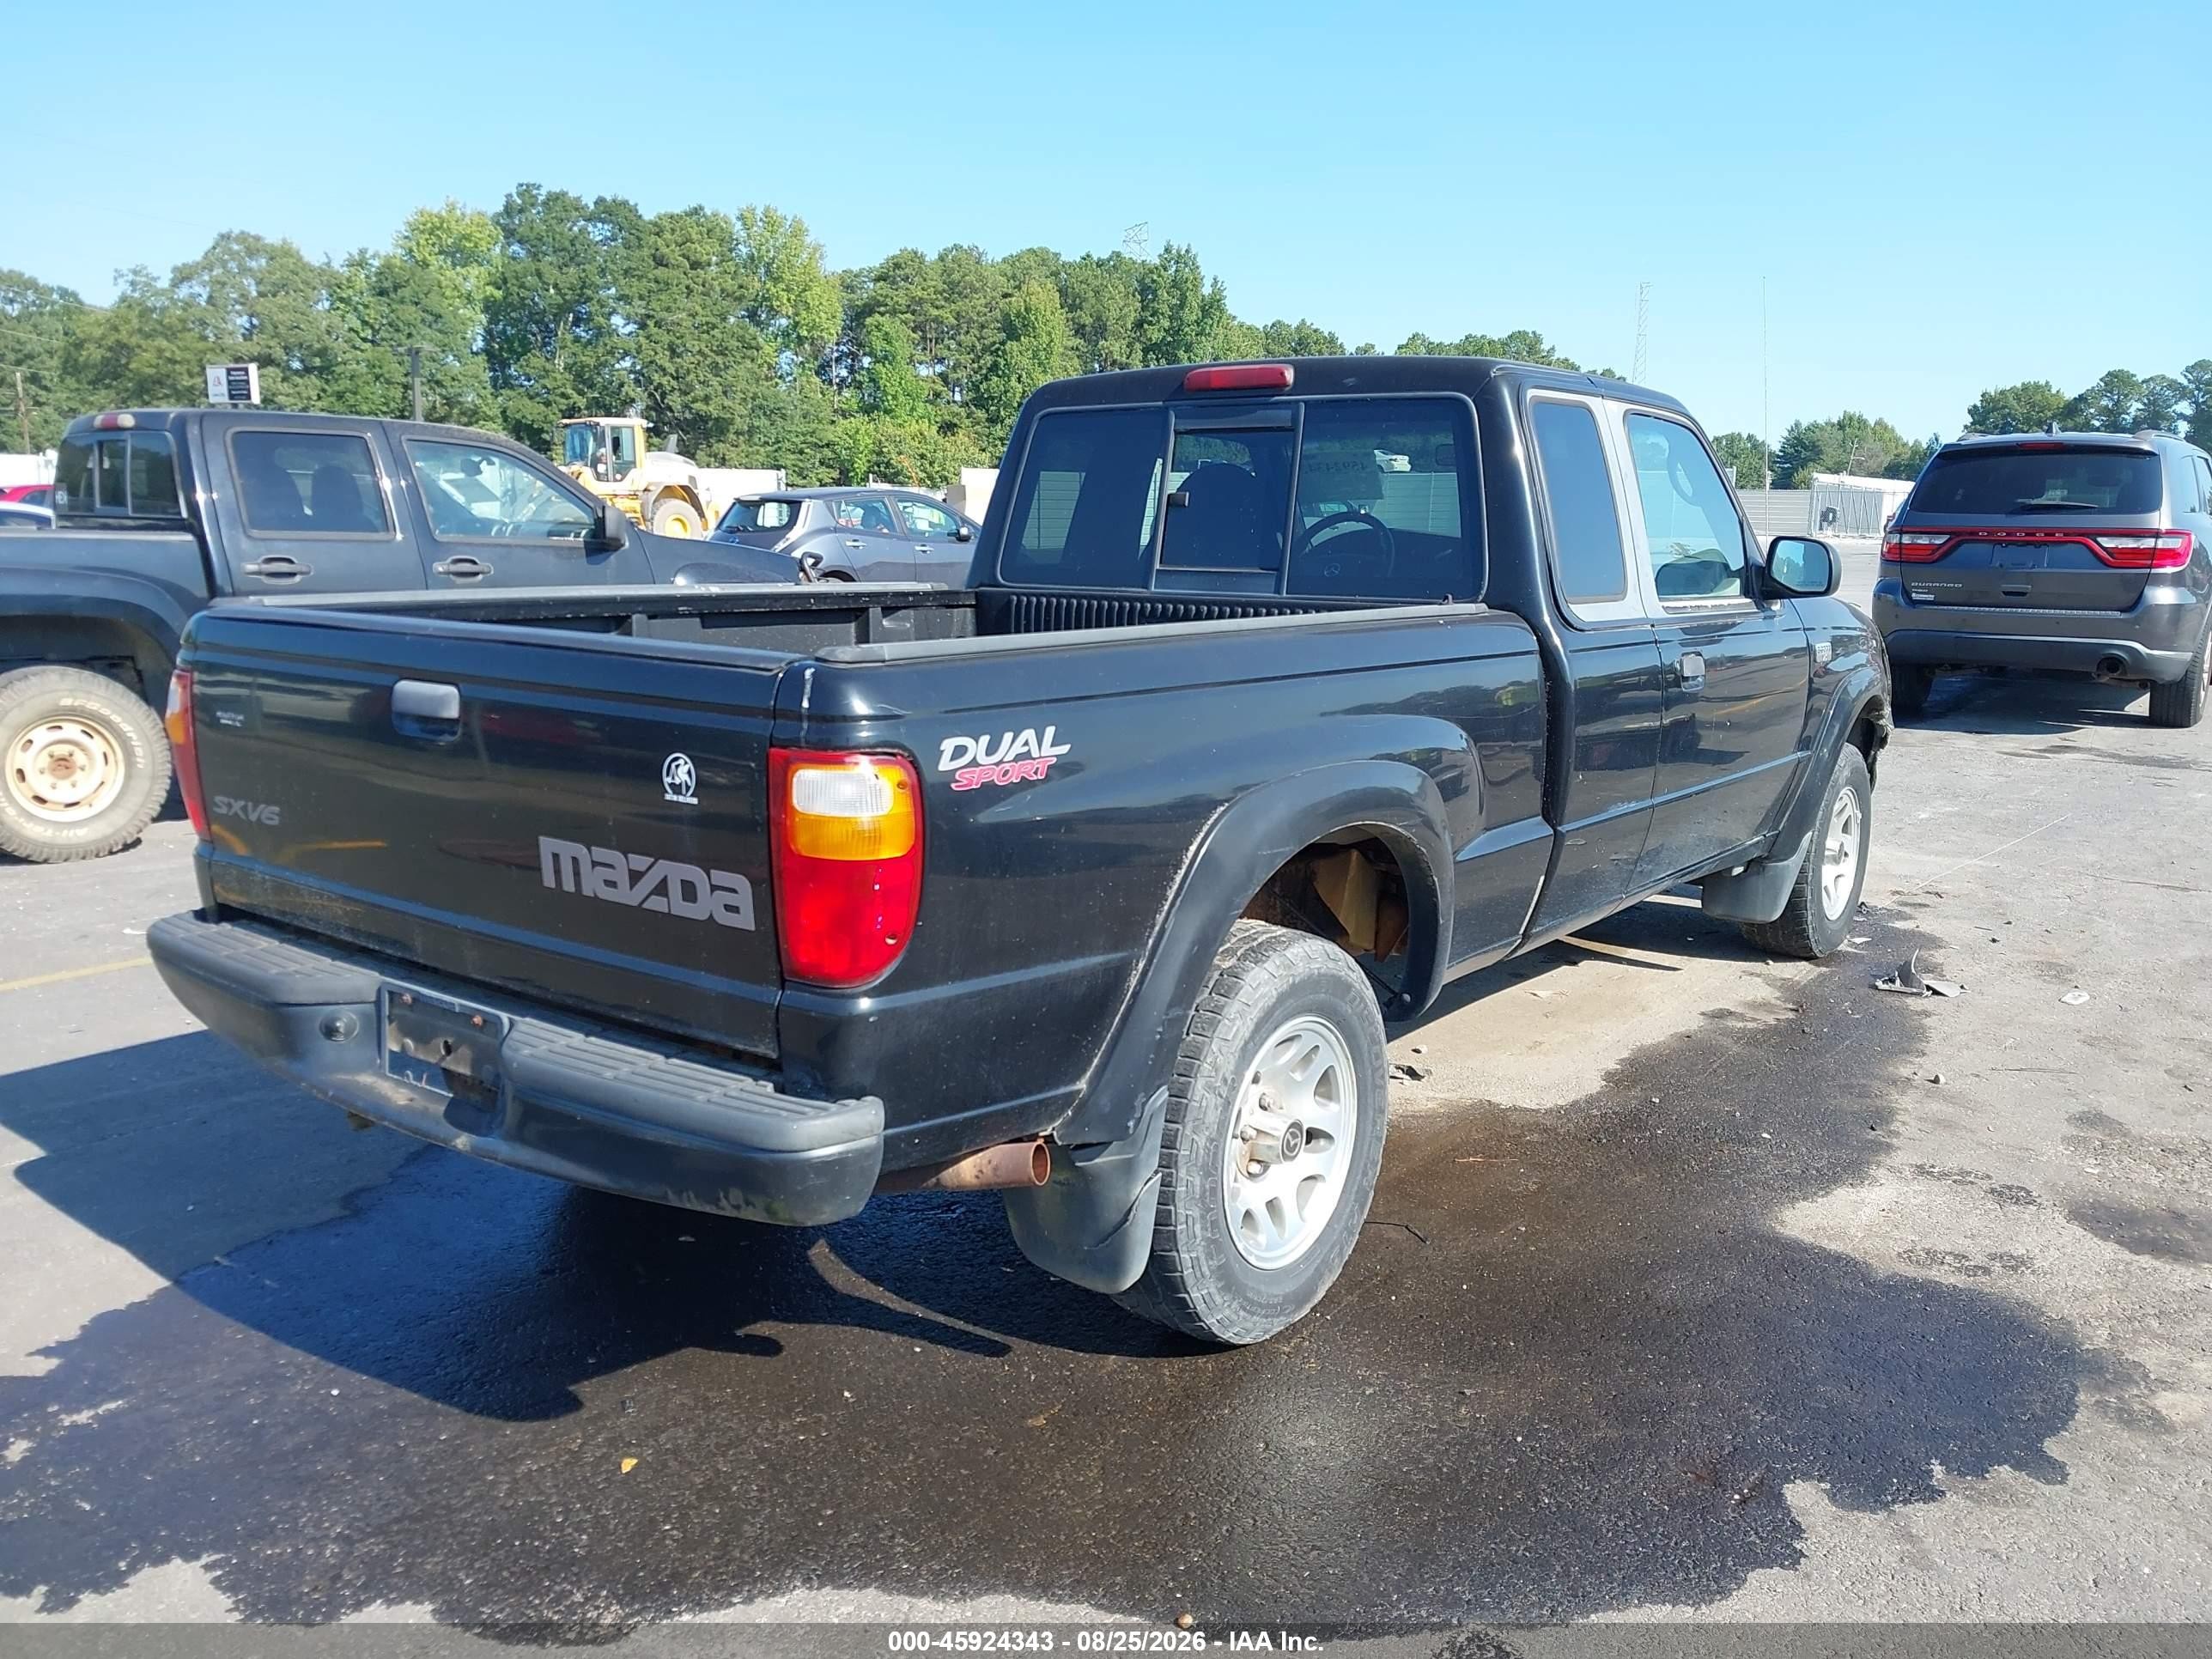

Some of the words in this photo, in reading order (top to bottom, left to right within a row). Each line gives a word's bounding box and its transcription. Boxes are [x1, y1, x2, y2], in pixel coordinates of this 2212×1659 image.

[938, 726, 1072, 771] DUAL
[951, 757, 1057, 791] SPORT
[213, 796, 280, 825] SXV6
